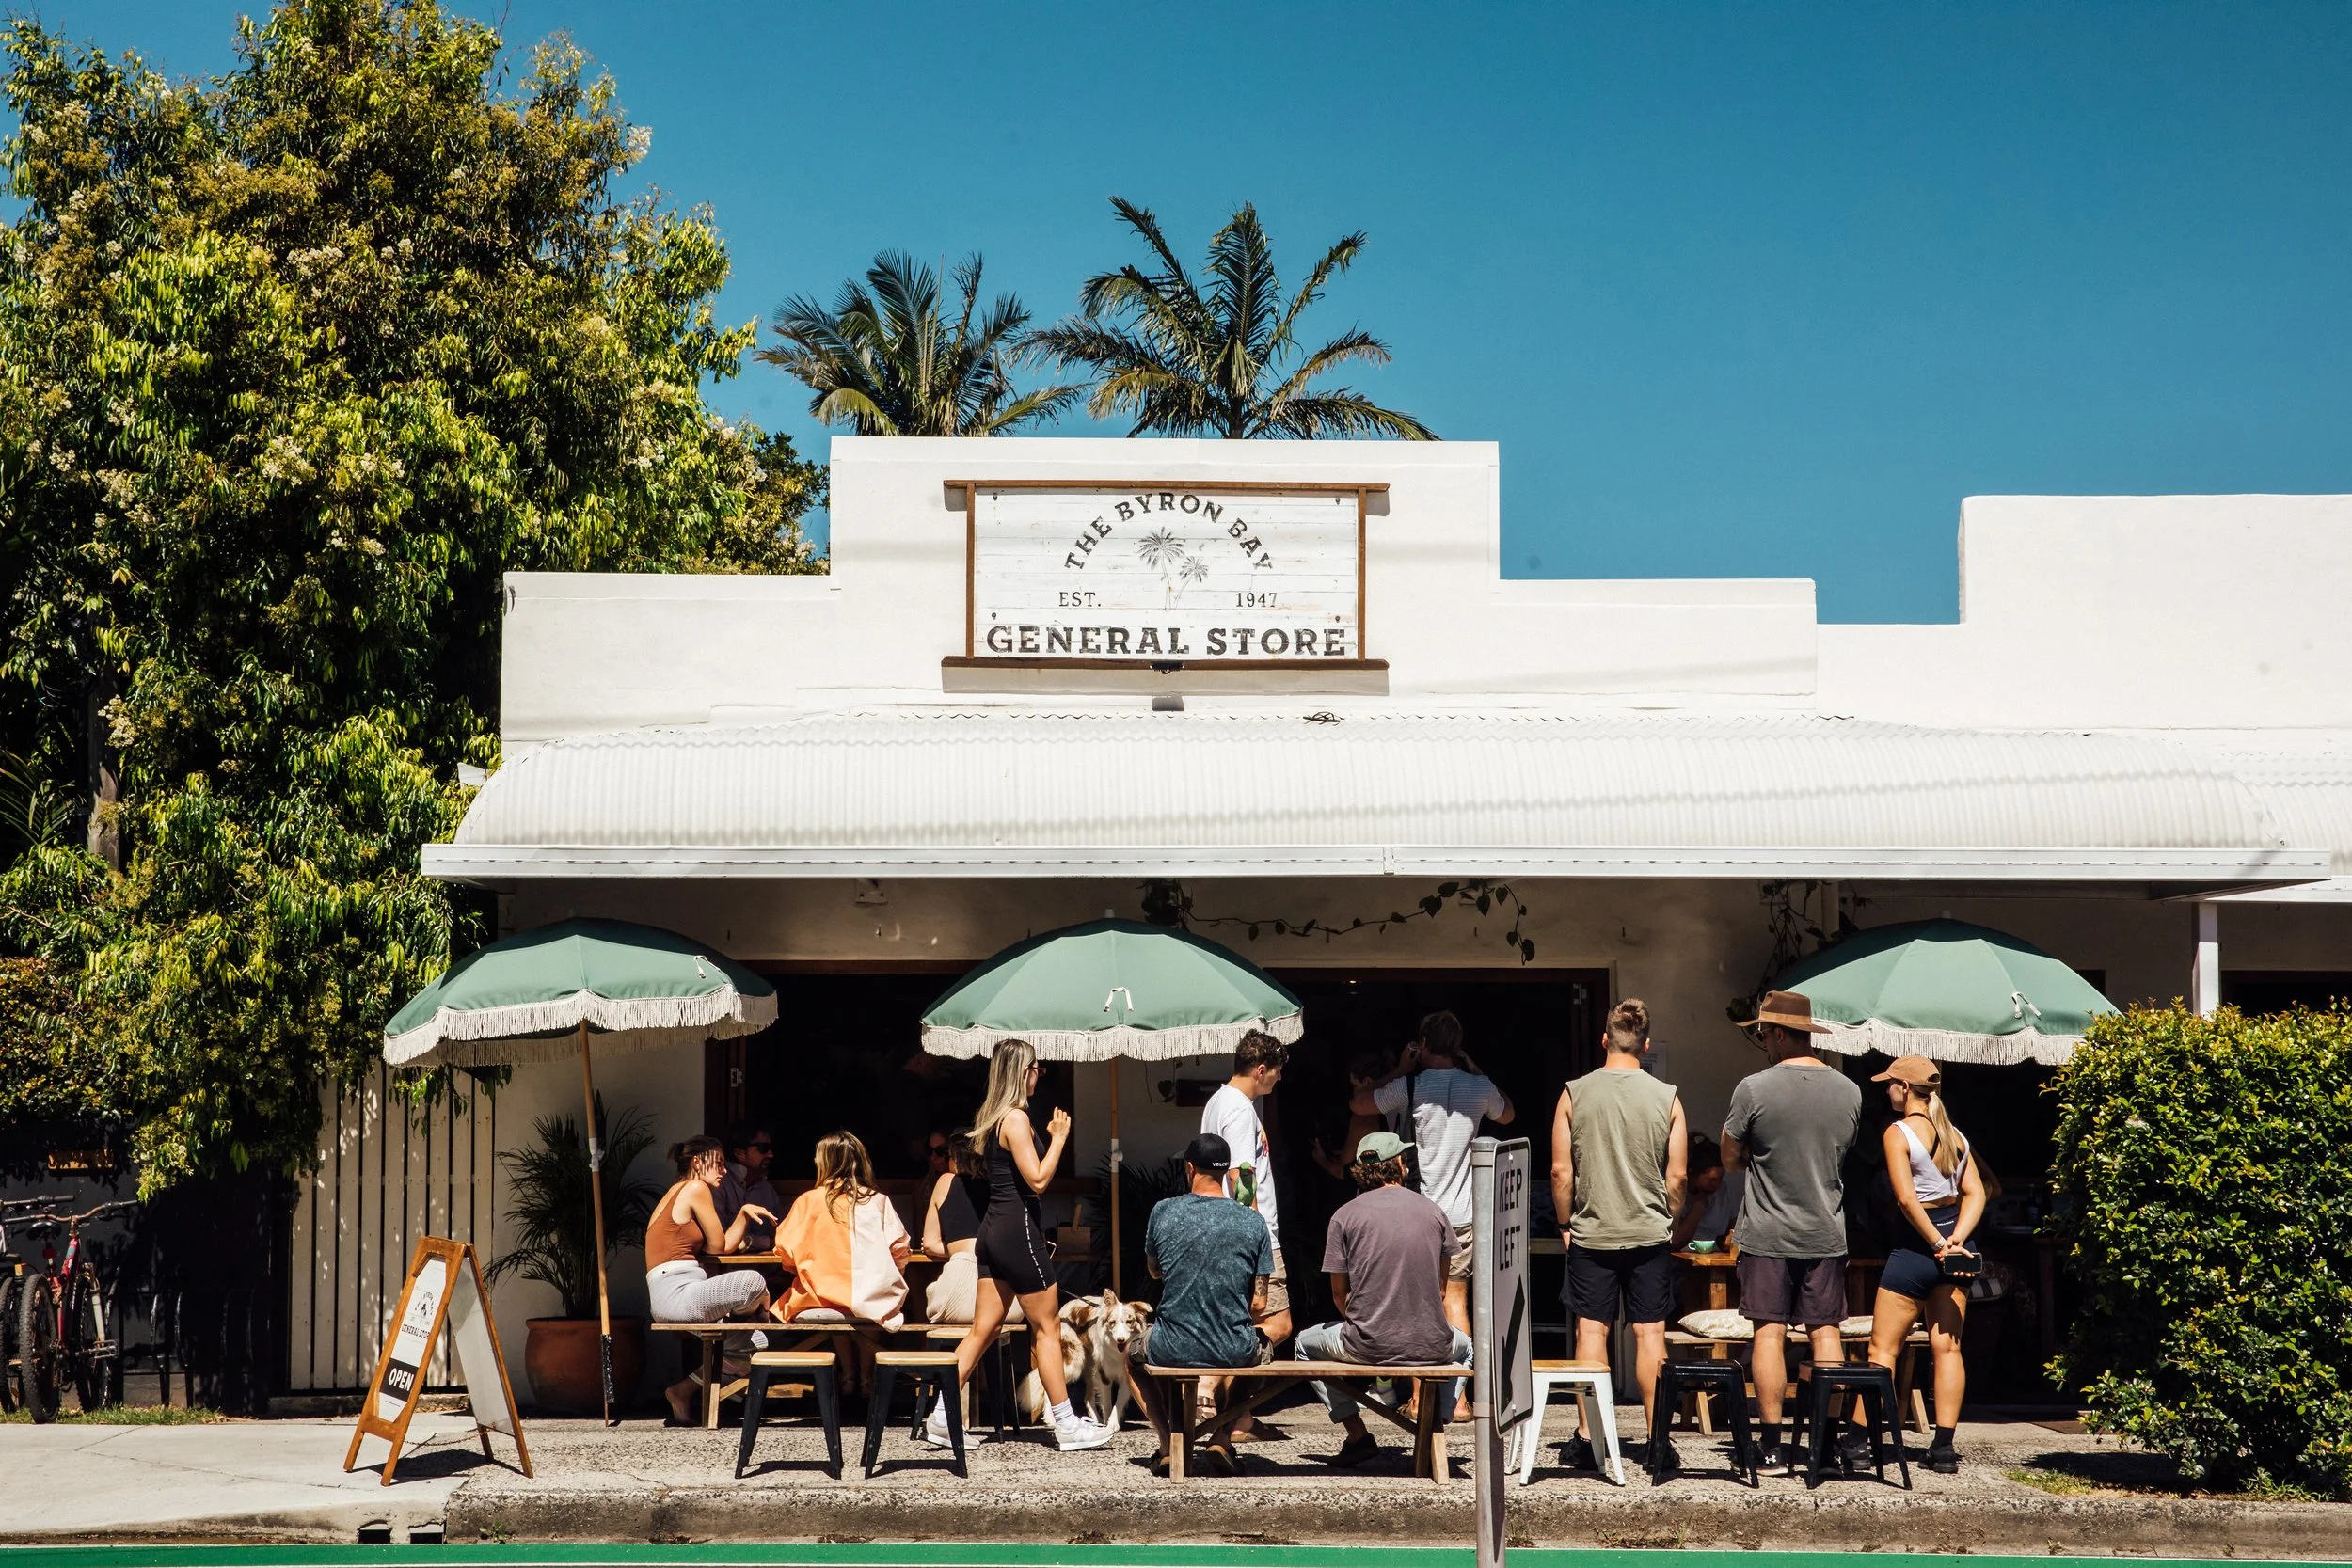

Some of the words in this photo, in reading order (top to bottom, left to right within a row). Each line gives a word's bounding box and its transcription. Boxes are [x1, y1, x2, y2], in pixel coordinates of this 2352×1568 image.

[1064, 515, 1113, 570] THE
[1114, 492, 1224, 523] BYRON
[1227, 517, 1273, 570] BAY
[1058, 592, 1102, 608] EST.
[1235, 592, 1279, 608] 1947
[987, 625, 1190, 655] GENERAL
[1206, 627, 1346, 657] STORE
[1500, 1168, 1522, 1213] KEEP
[1500, 1225, 1521, 1271] LEFT
[402, 1323, 420, 1337] GENERAL
[388, 1367, 415, 1392] OPEN
